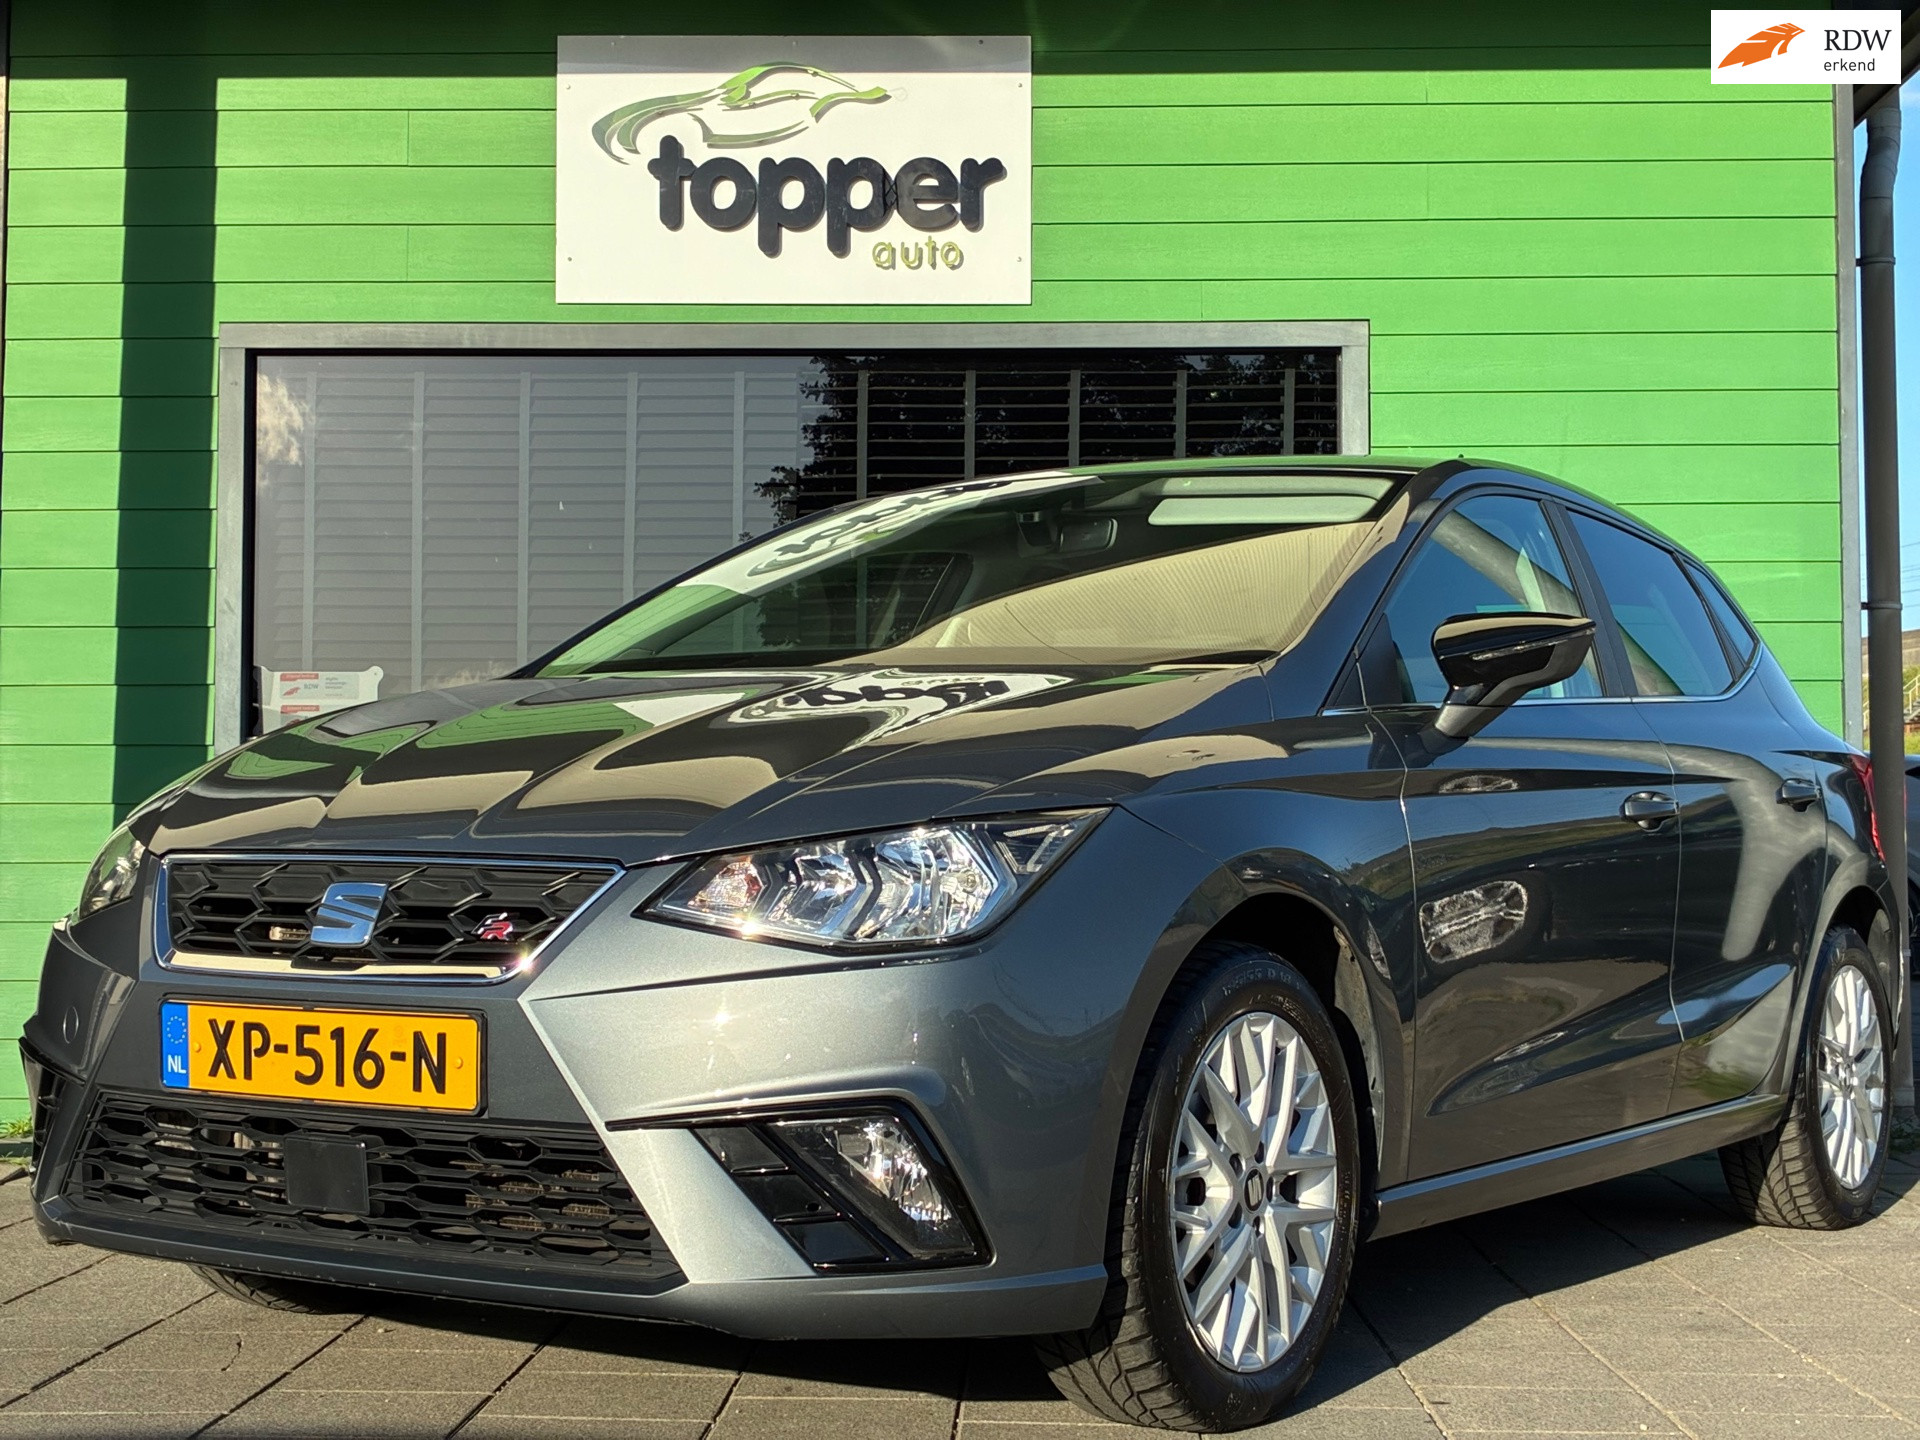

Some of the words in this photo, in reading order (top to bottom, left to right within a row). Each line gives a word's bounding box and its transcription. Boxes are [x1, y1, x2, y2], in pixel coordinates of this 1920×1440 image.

[647, 134, 1007, 257] topper
[872, 235, 964, 271] auto
[167, 1053, 187, 1075] NL
[207, 1017, 448, 1095] XP-516-N
